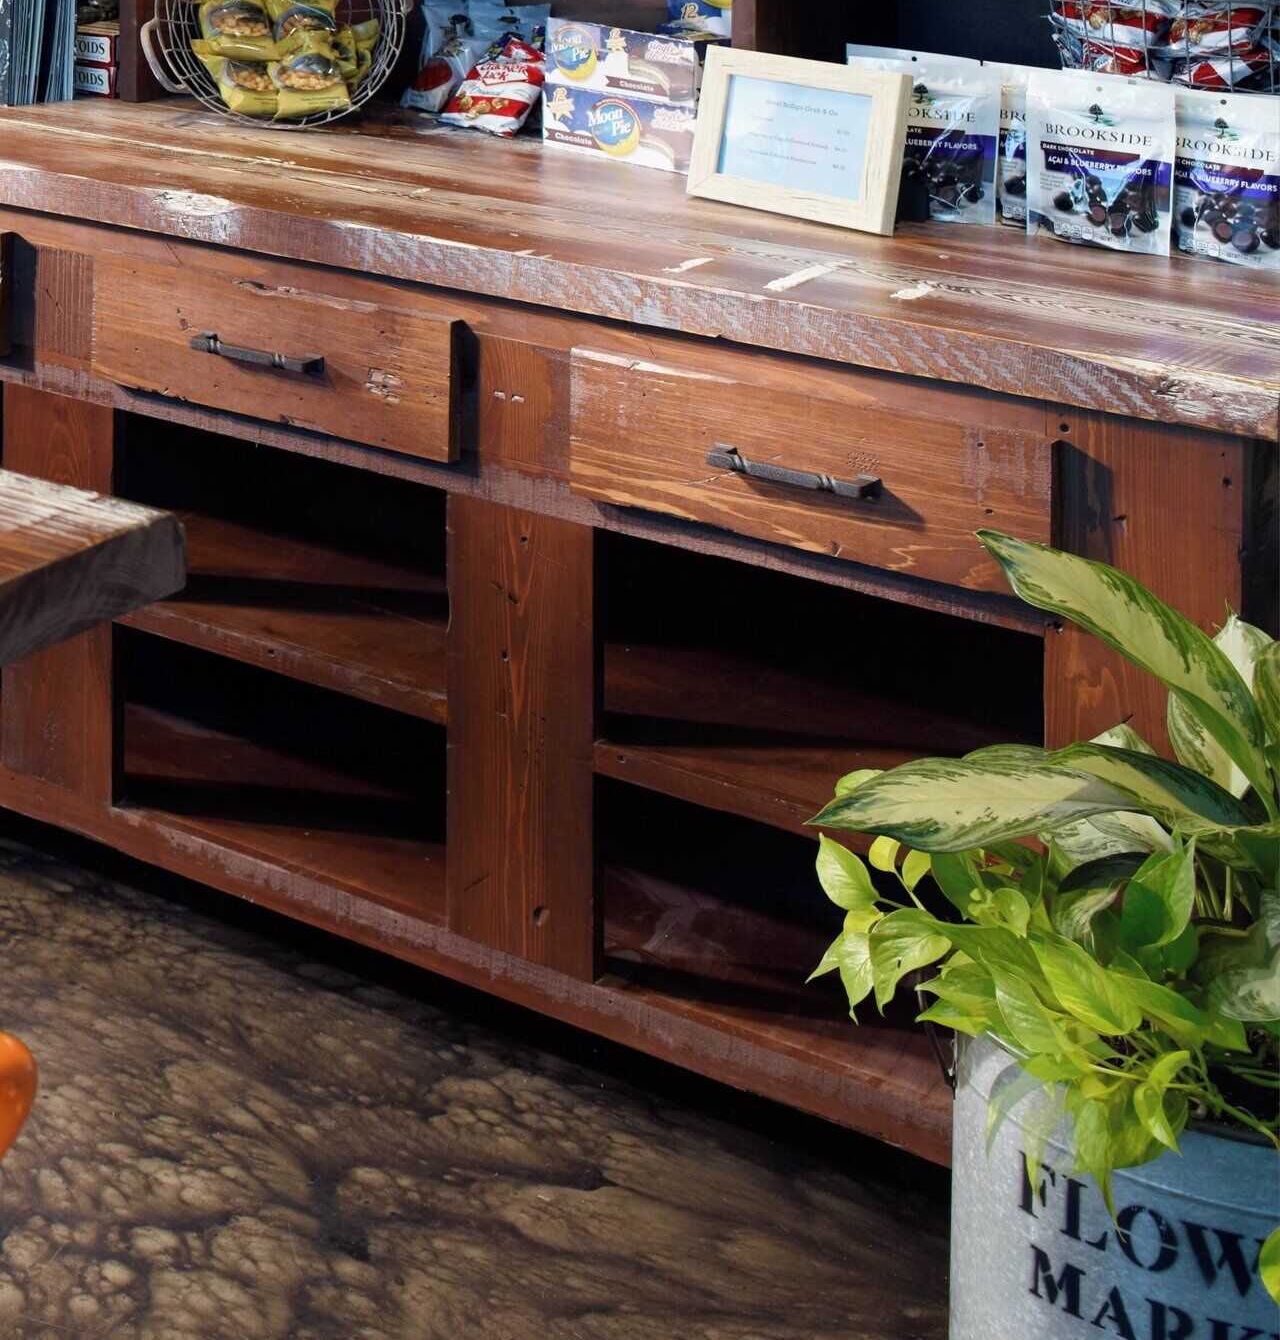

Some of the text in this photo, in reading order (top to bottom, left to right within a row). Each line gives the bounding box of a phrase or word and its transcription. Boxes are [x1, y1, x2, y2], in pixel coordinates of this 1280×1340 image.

[681, 3, 698, 20] 12
[573, 46, 589, 62] Pie
[620, 80, 654, 92] Chocolate
[783, 101, 803, 111] Indigo
[805, 105, 821, 114] Grab
[908, 107, 976, 122] OKSIDE
[588, 109, 623, 126] Moon
[612, 121, 631, 136] Pie
[1045, 123, 1152, 146] BROOKSIDE
[555, 132, 592, 145] Chocolate
[905, 138, 977, 150] LUEBERRY FLAVORS
[1058, 145, 1094, 155] CHOCOLATE
[1071, 159, 1115, 170] BLUEBERRY
[1117, 165, 1152, 176] FLAVORS
[1182, 160, 1220, 170] CHOCOLATE
[1241, 181, 1278, 192] FLAVORS
